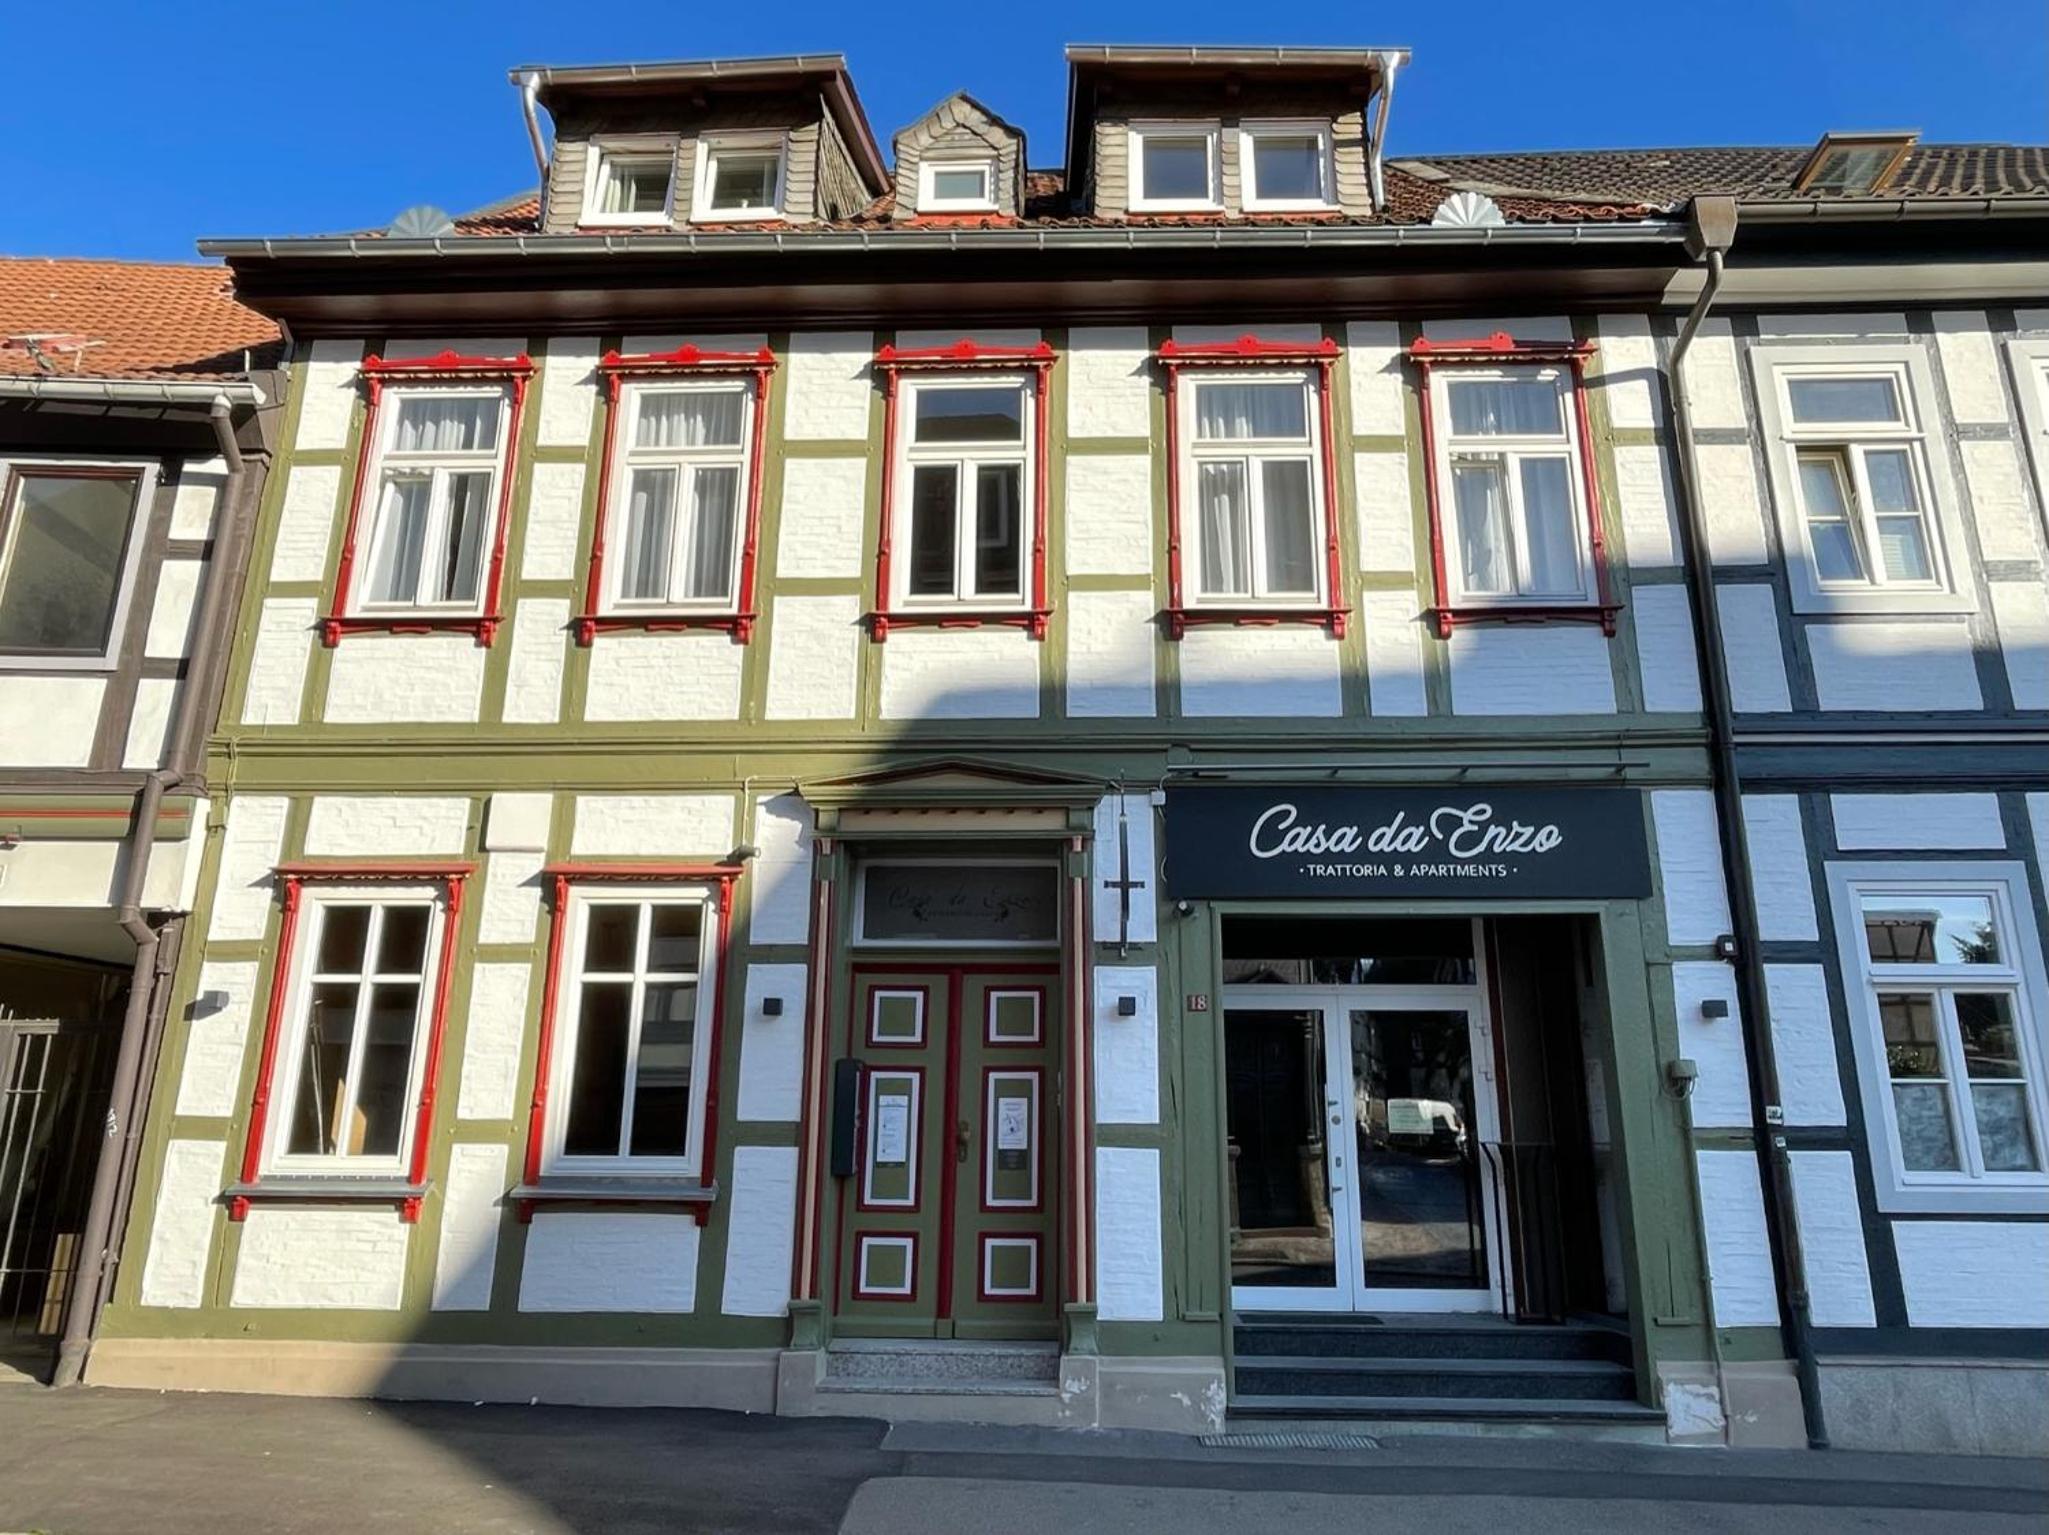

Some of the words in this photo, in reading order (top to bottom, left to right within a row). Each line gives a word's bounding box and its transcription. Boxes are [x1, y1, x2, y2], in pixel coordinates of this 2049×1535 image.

[1250, 803, 1362, 858] Casa
[1368, 811, 1429, 852] da
[1430, 803, 1563, 858] Enzo
[1307, 864, 1387, 877] TRATTORIA
[1394, 864, 1405, 877] &
[1410, 864, 1507, 877] APARTMENTS
[1192, 995, 1206, 1010] 18
